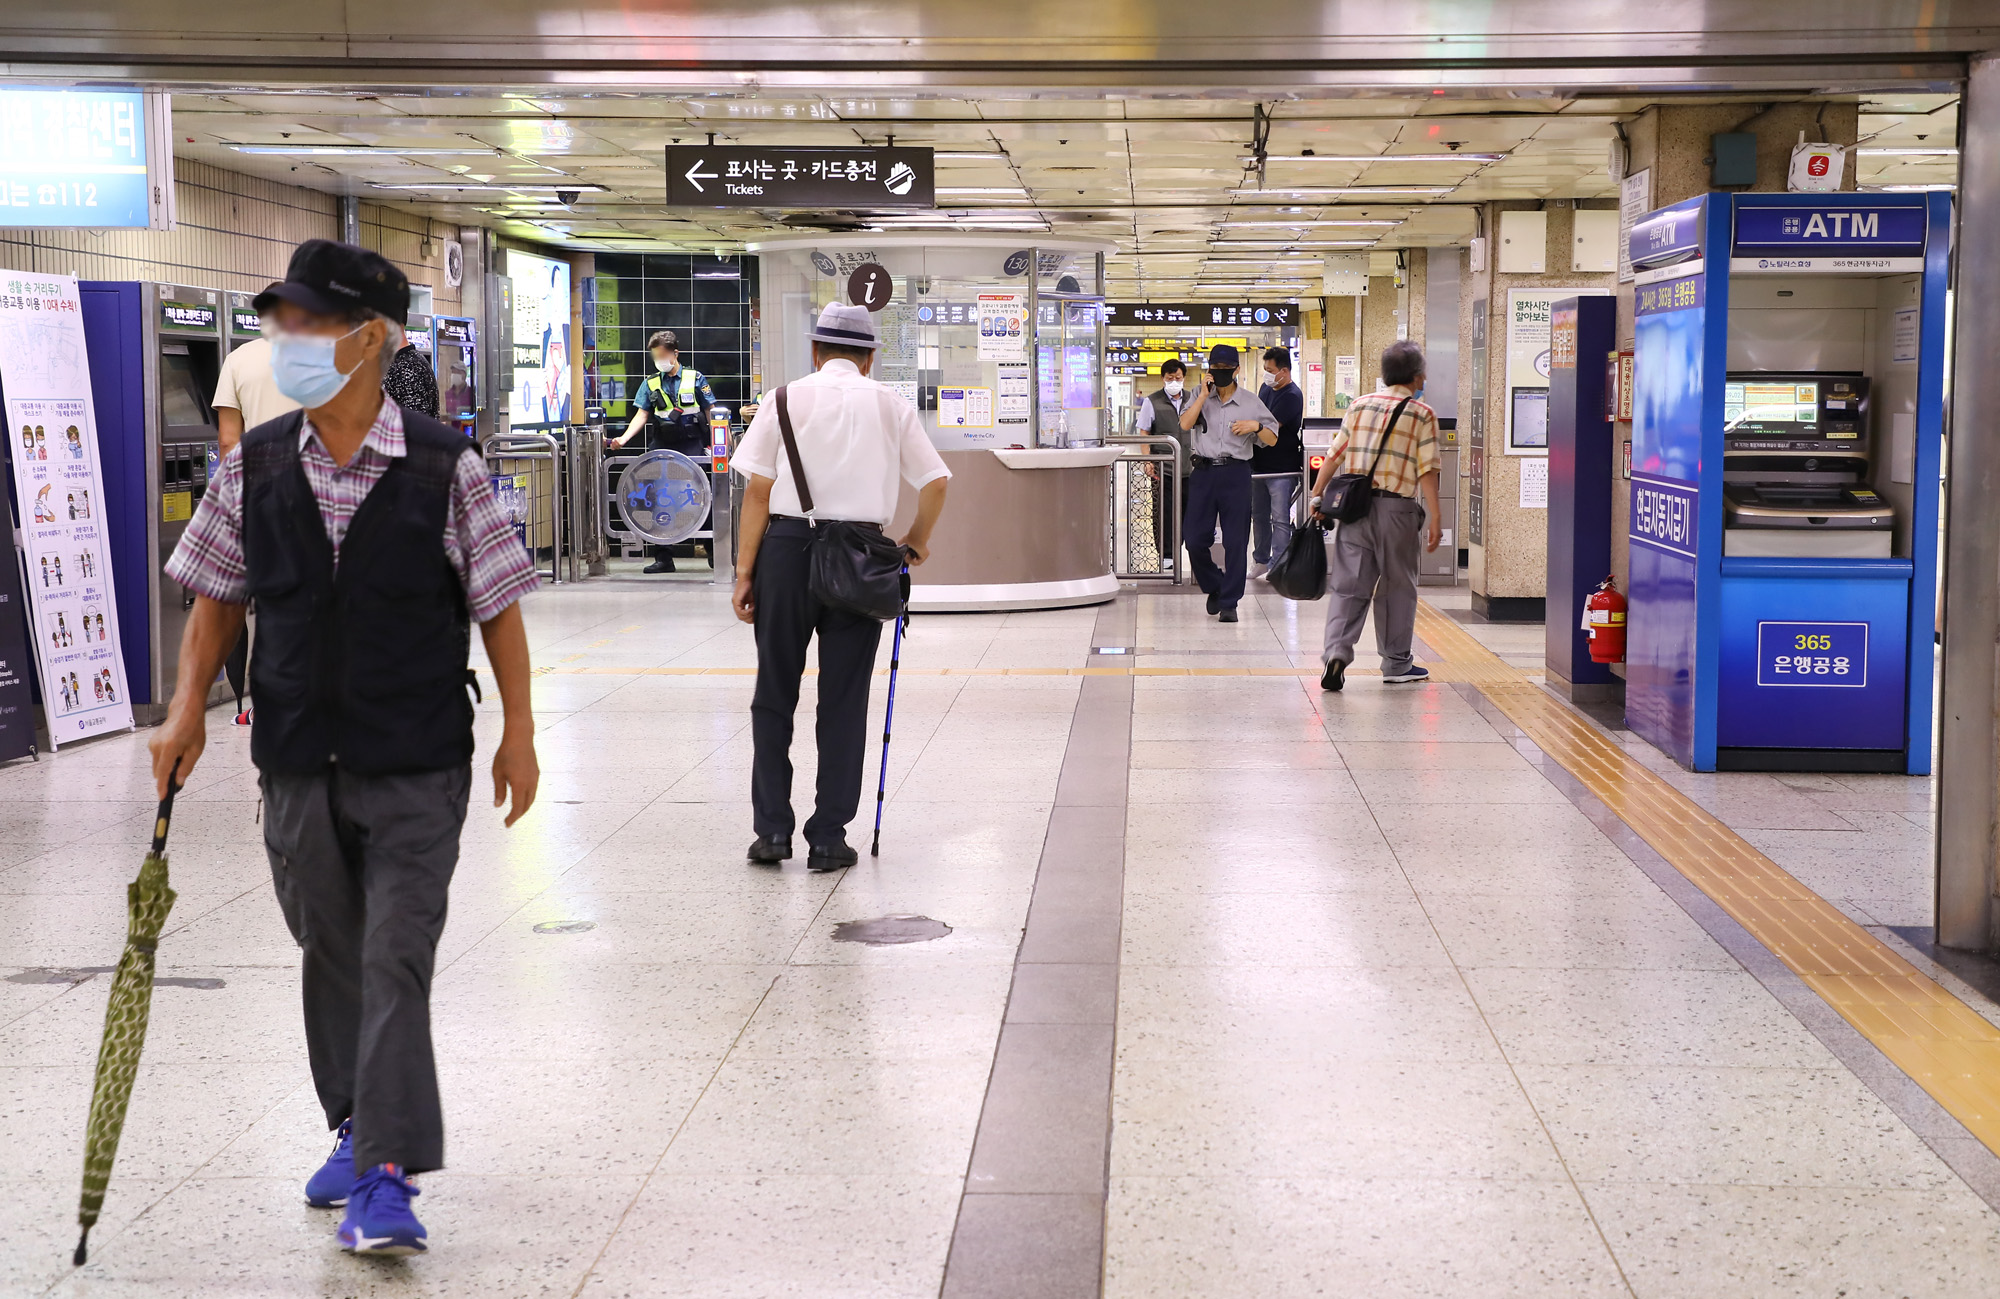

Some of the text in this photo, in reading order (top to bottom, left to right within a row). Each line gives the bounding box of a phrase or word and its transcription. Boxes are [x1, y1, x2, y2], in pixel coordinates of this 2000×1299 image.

[42, 97, 136, 159] 경찰센터
[725, 159, 777, 181] 표사는
[780, 160, 799, 181] 곳
[811, 159, 877, 182] 카드충전
[59, 182, 98, 207] 112
[725, 183, 764, 196] Tickets
[1802, 213, 1879, 238] ATM
[1661, 222, 1676, 247] ATM
[835, 251, 877, 264] 종로3가
[1008, 257, 1029, 270] 130
[1769, 260, 1812, 268] 노틸러스효성
[1847, 260, 1891, 268] 현금자동지급기
[8, 280, 62, 297] 생활 속 거리두기
[1674, 280, 1696, 307] 은행공용
[26, 297, 40, 311] 이용
[42, 299, 59, 312] 10대
[60, 299, 78, 313] 수칙!
[1516, 300, 1550, 311] 열차시간
[1134, 309, 1165, 321] 타는 곳
[1260, 310, 1264, 320] 1
[1516, 311, 1550, 322] 알아보는
[1623, 358, 1632, 417] 휴대용비상조명등
[1636, 487, 1690, 545] 현금자동지급기
[1794, 634, 1831, 650] 365
[1774, 655, 1850, 675] 은행공용
